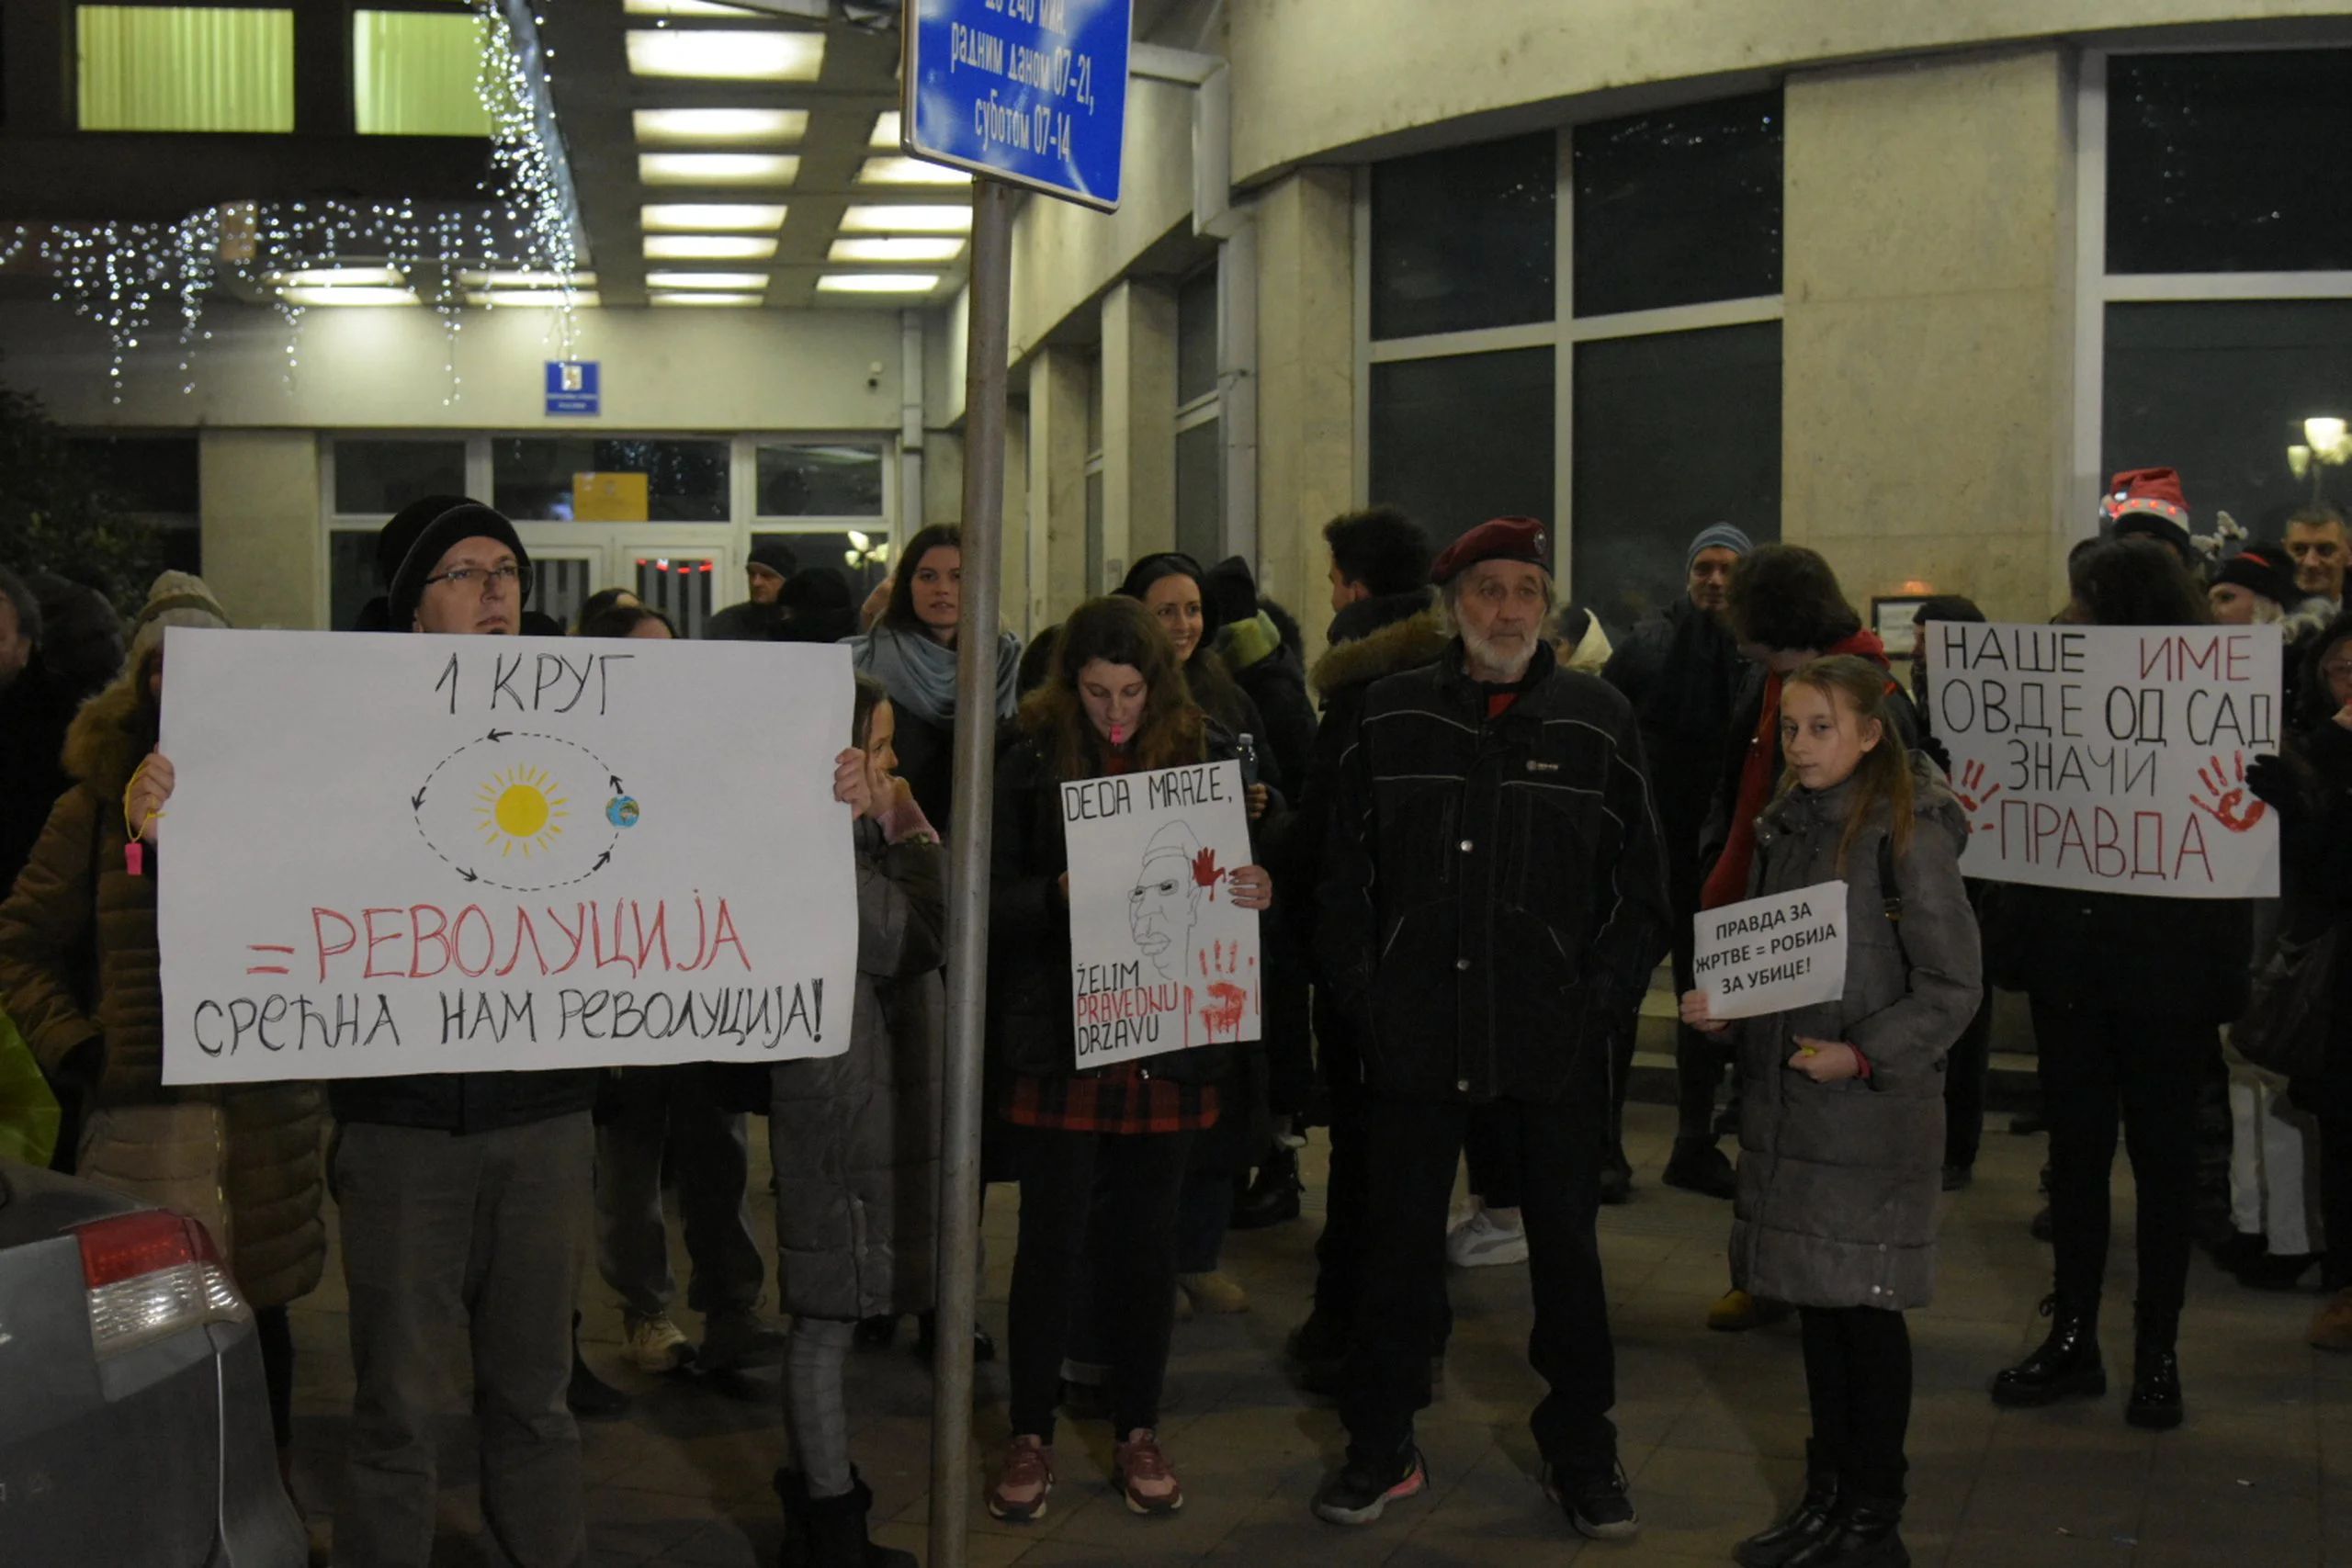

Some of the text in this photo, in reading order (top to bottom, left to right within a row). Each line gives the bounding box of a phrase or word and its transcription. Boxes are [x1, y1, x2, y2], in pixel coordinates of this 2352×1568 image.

[951, 22, 1094, 116] радним даном 07-21,
[975, 89, 1070, 163] суботом 07-14
[1943, 626, 2252, 682] НАШЕ ИМЕ
[435, 652, 635, 715] 1 КРУГ
[1941, 678, 2275, 749] ОВДЕ ОД САД
[1065, 766, 1233, 821] DEDA MRAZE,
[2007, 739, 2156, 796] ЗНАЧИ
[2000, 799, 2214, 883] ПРАВДА
[1696, 944, 1751, 975] ЖРТВЕ
[1770, 923, 1838, 955] РОБИЈА
[1716, 902, 1813, 941] ПРАВДА ЗА
[1077, 960, 1139, 997] ŽELIM
[1077, 980, 1179, 1027] PRAVEDNU
[1721, 957, 1812, 995] ЗА УБИЦЕ!
[439, 987, 537, 1044] НАМ
